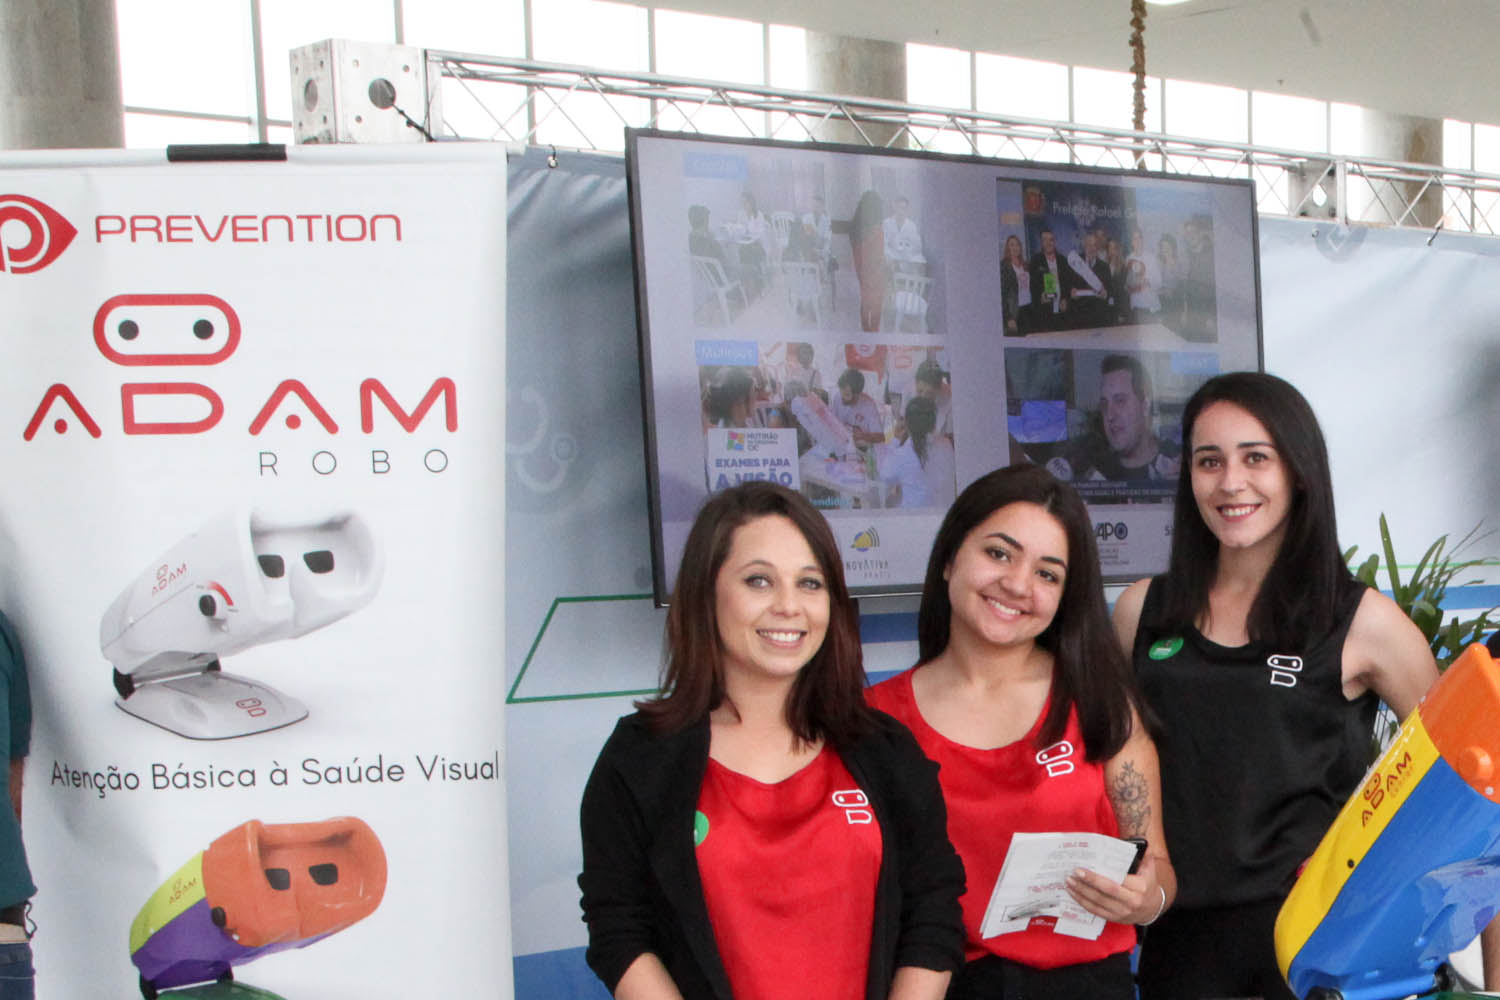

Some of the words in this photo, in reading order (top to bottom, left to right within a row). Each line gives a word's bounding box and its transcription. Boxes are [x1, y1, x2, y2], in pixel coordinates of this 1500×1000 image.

[95, 214, 402, 242] PREVENTION
[23, 376, 458, 442] ADAM
[259, 448, 448, 477] ROBO
[762, 457, 791, 468] PARA
[50, 760, 141, 799] Atenção
[151, 762, 257, 790] Básica
[269, 759, 289, 787] à
[301, 754, 405, 784] Saúde
[416, 750, 500, 781] Visual
[1361, 751, 1412, 828] ADAM
